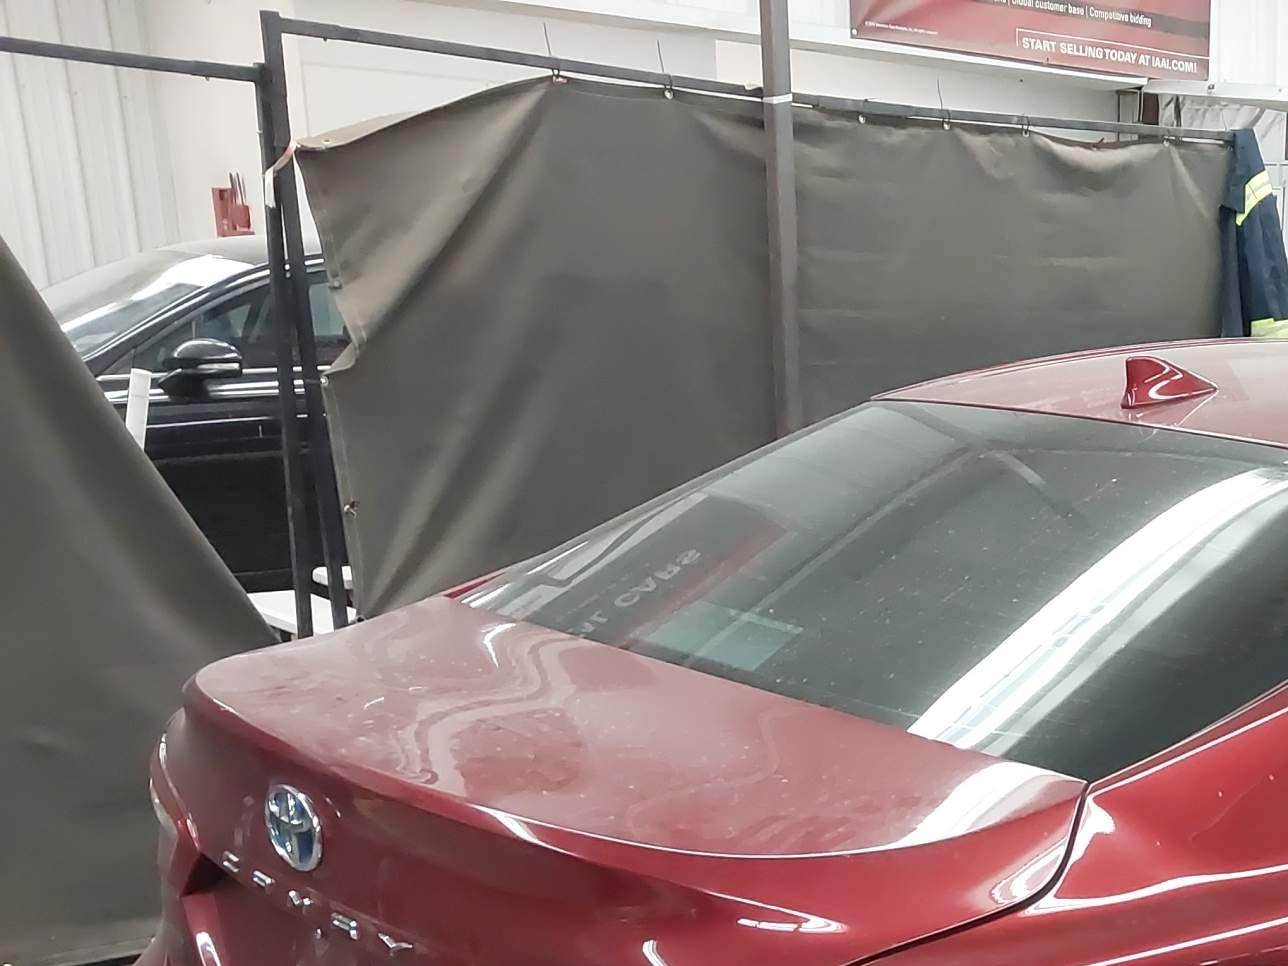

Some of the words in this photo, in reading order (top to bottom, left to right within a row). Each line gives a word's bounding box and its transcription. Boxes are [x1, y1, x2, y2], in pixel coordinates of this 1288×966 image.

[1035, 1, 1068, 12] customer
[1068, 4, 1084, 15] base
[1089, 6, 1128, 21] Competitive
[1129, 12, 1152, 28] bidding
[1022, 37, 1056, 52] START
[1060, 42, 1104, 59] SELLING
[1104, 47, 1137, 64] TODAY
[1138, 53, 1151, 66] AT
[1151, 55, 1197, 73] IAAI.COM!
